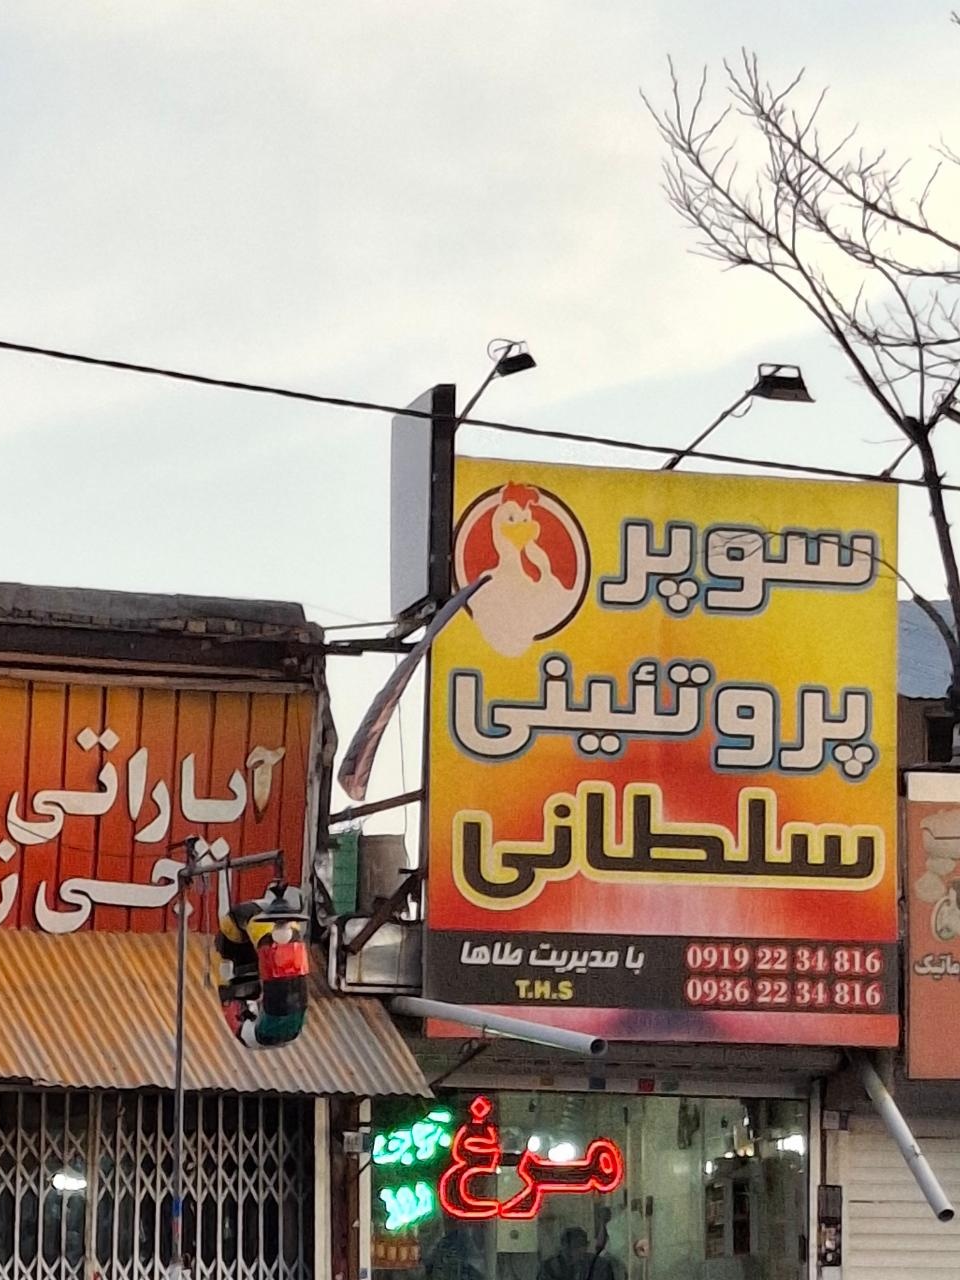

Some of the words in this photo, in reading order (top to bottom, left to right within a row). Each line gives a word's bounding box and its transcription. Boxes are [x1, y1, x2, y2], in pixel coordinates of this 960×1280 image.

[598, 517, 879, 614] سوپر
[450, 656, 878, 779] پروتئینی
[7, 727, 286, 864] آپاراتی
[453, 781, 884, 909] سلطانی
[460, 941, 522, 967] طاها
[528, 943, 620, 974] مدیریت
[624, 945, 645, 974] با
[686, 944, 750, 971] 0919
[756, 947, 789, 971] 22
[795, 948, 827, 972] 34
[833, 948, 882, 974] 816
[515, 978, 575, 1001] T.H.S
[686, 978, 750, 1003] 0936
[756, 979, 789, 1004] 22
[795, 981, 827, 1005] 34
[833, 981, 882, 1006] 816
[438, 1095, 623, 1221] مرغ
